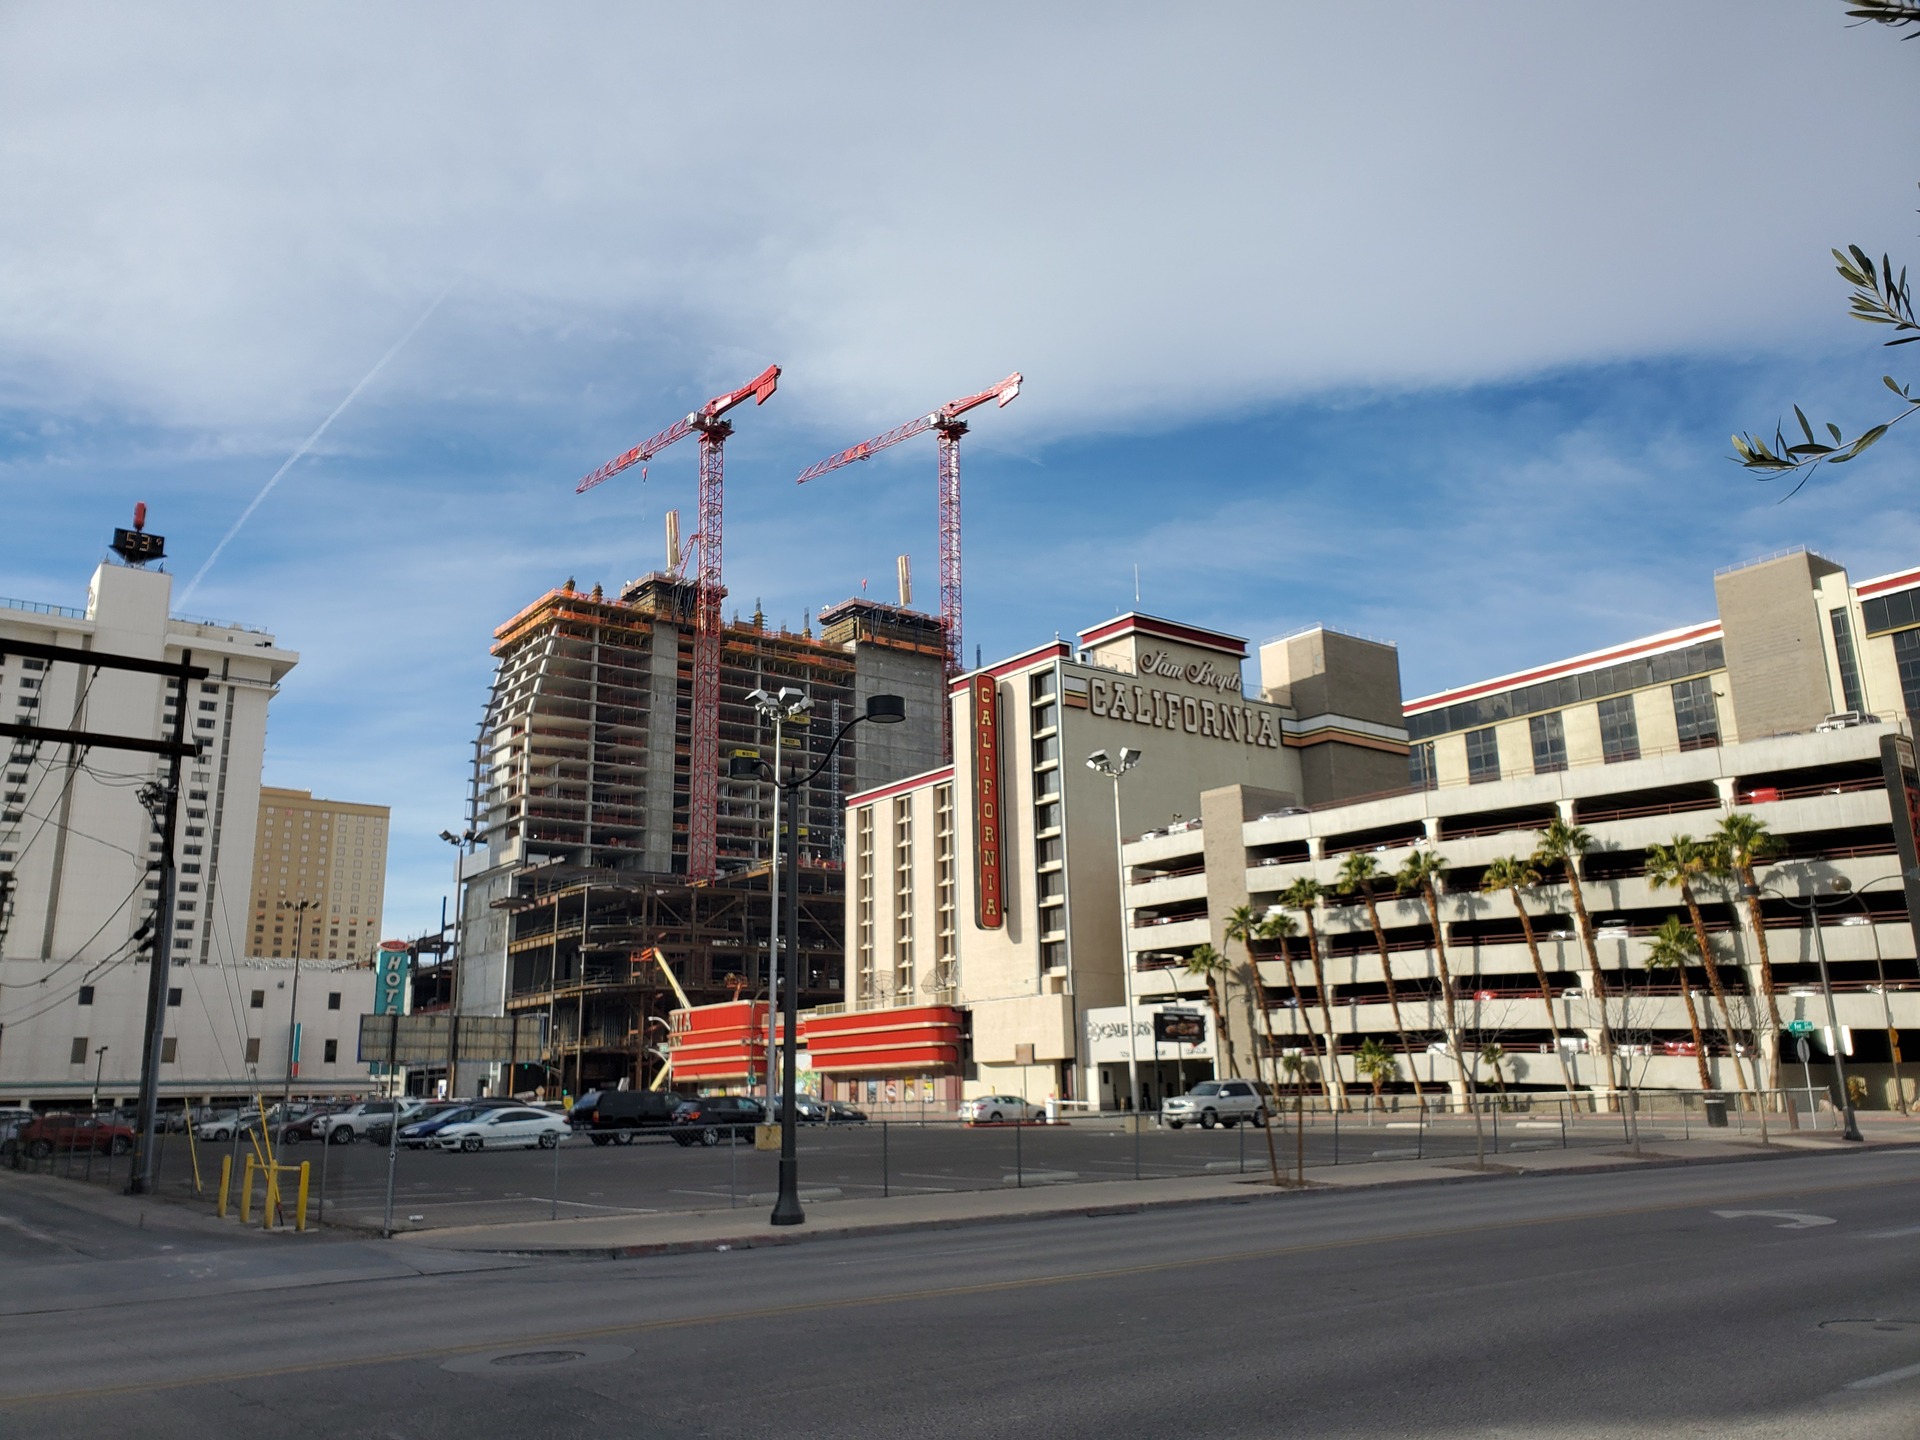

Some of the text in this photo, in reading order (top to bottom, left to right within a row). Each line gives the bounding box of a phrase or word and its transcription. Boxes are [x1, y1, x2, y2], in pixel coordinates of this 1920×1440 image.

[1139, 650, 1184, 680] Sam
[1090, 677, 1278, 748] CALIFORNIA
[981, 687, 997, 917] CALIFORNIA
[386, 956, 401, 1015] HOTE
